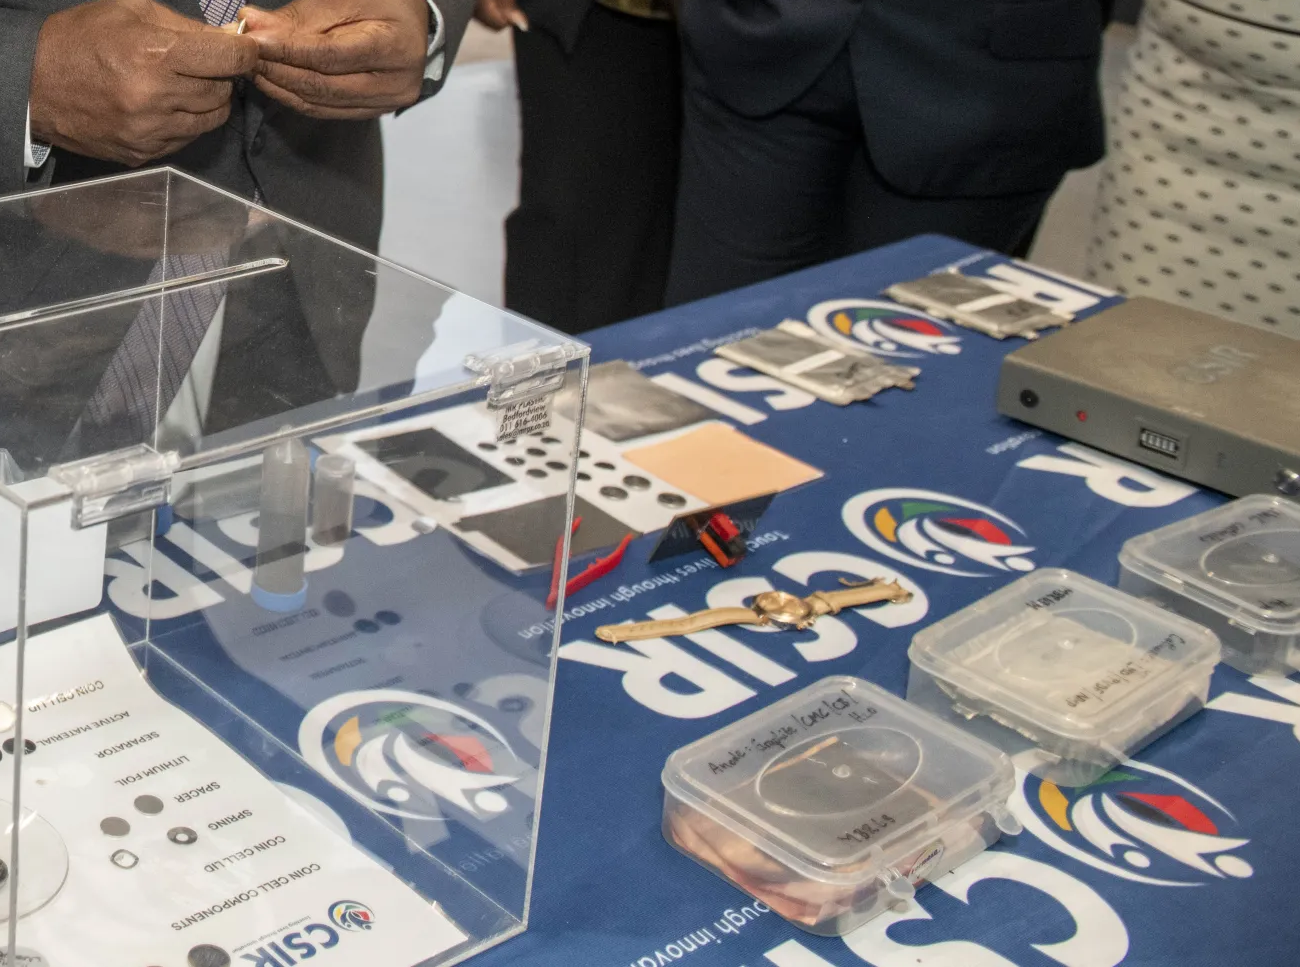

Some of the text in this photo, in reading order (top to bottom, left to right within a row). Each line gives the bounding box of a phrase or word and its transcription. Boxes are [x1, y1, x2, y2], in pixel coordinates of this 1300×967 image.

[651, 358, 816, 425] SI
[503, 405, 546, 424] Bedfordview
[610, 575, 680, 605] through
[547, 550, 929, 719] CSIR
[75, 680, 105, 697] COIN
[36, 710, 130, 746] ACTIVE MATERIAL
[94, 731, 160, 758] SEPARATOR
[114, 755, 190, 786] LITHIUM FOIL
[174, 781, 221, 803] SPACER
[207, 809, 253, 831] SPRING
[204, 835, 286, 873] COIN CELL LID
[171, 863, 321, 931] COIN CELL COMPONENTS
